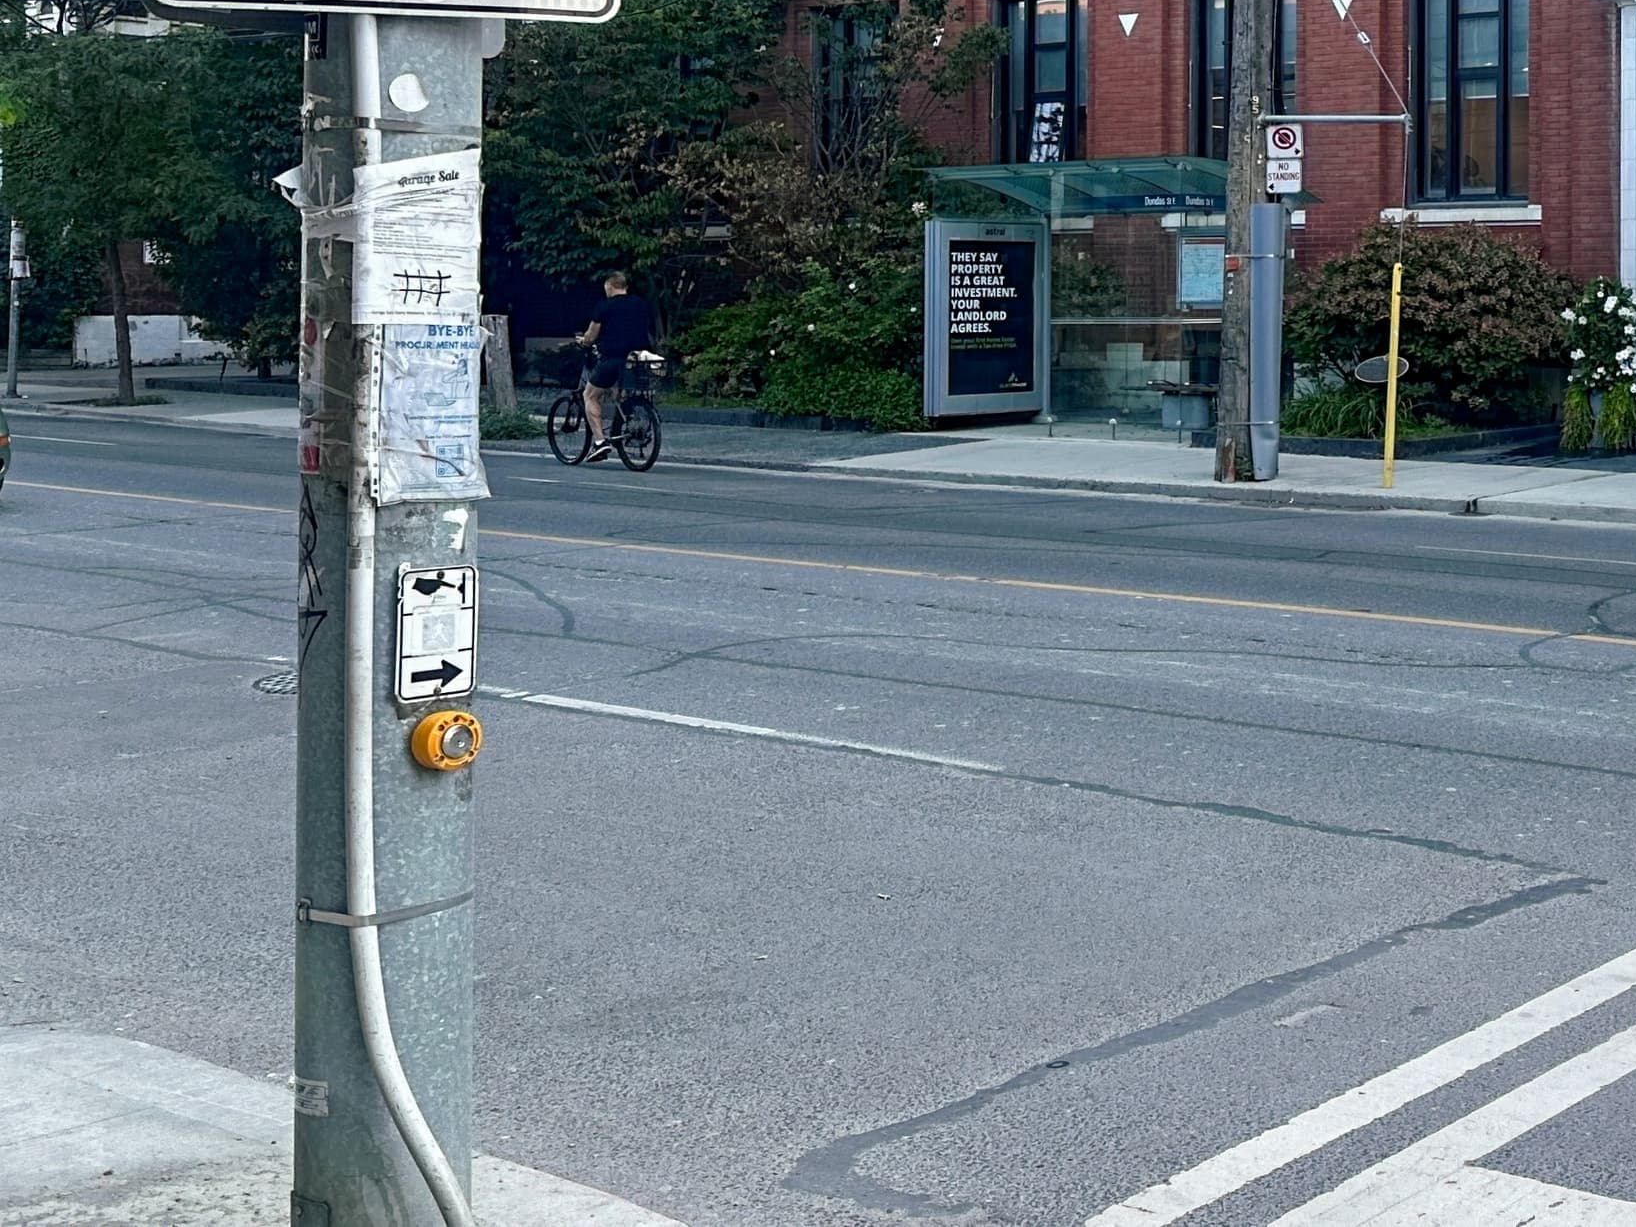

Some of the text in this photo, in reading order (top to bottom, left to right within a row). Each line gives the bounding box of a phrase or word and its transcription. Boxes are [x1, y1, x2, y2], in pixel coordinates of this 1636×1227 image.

[1278, 162, 1289, 171] NO
[438, 170, 460, 182] Sale
[1267, 172, 1300, 181] STANDING
[950, 252, 999, 262] THEY SAY
[951, 264, 1003, 274] PROPERTY
[951, 275, 1005, 286] IS A GREAT
[951, 287, 1018, 298] INVESTMENT.
[950, 299, 981, 310] YOUR
[950, 311, 1007, 321] LANDLORD
[428, 324, 474, 336] BYE-BYE
[950, 323, 992, 333] AGREES.
